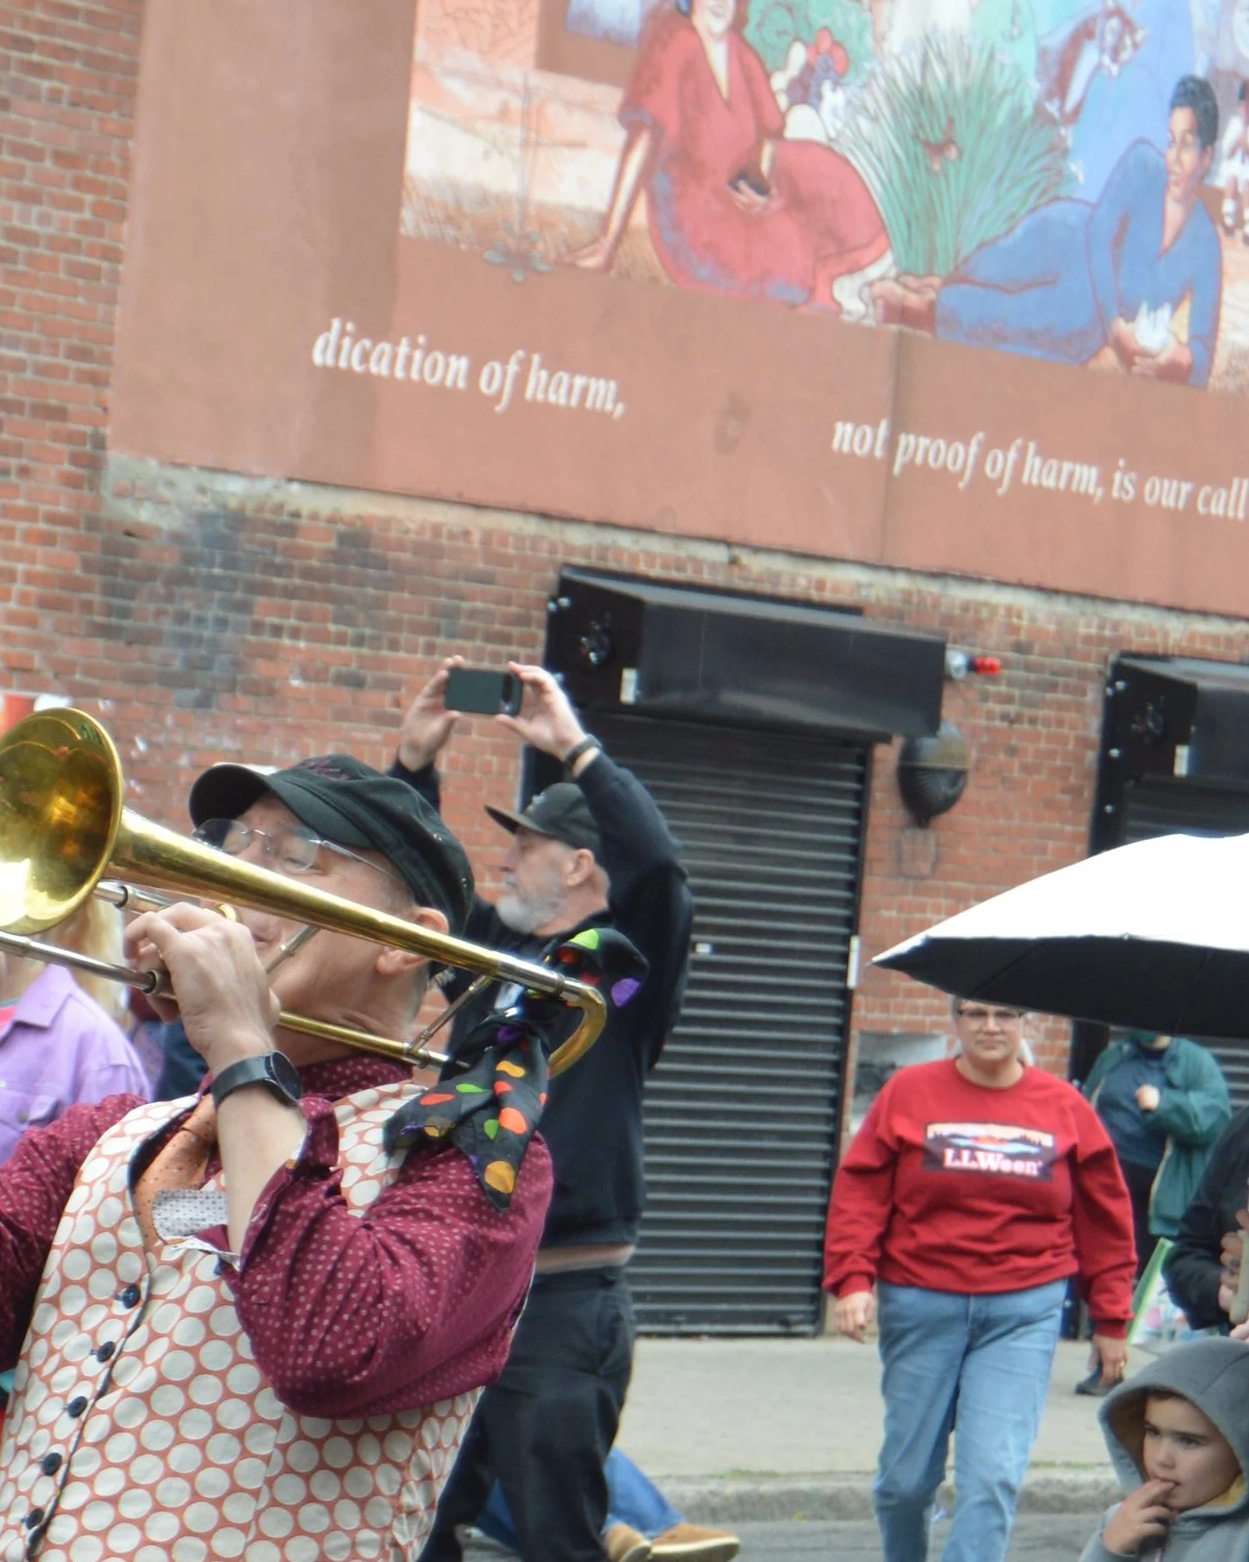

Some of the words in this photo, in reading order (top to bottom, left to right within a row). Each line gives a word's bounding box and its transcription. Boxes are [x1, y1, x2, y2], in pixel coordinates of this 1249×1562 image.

[311, 316, 471, 391] dication
[478, 348, 527, 414] of
[524, 352, 626, 421] harm,
[832, 417, 890, 461] not
[892, 431, 985, 491] proof
[984, 436, 1023, 497] of
[1022, 440, 1105, 504] harm,
[1111, 457, 1138, 503] is
[1143, 475, 1193, 511] our
